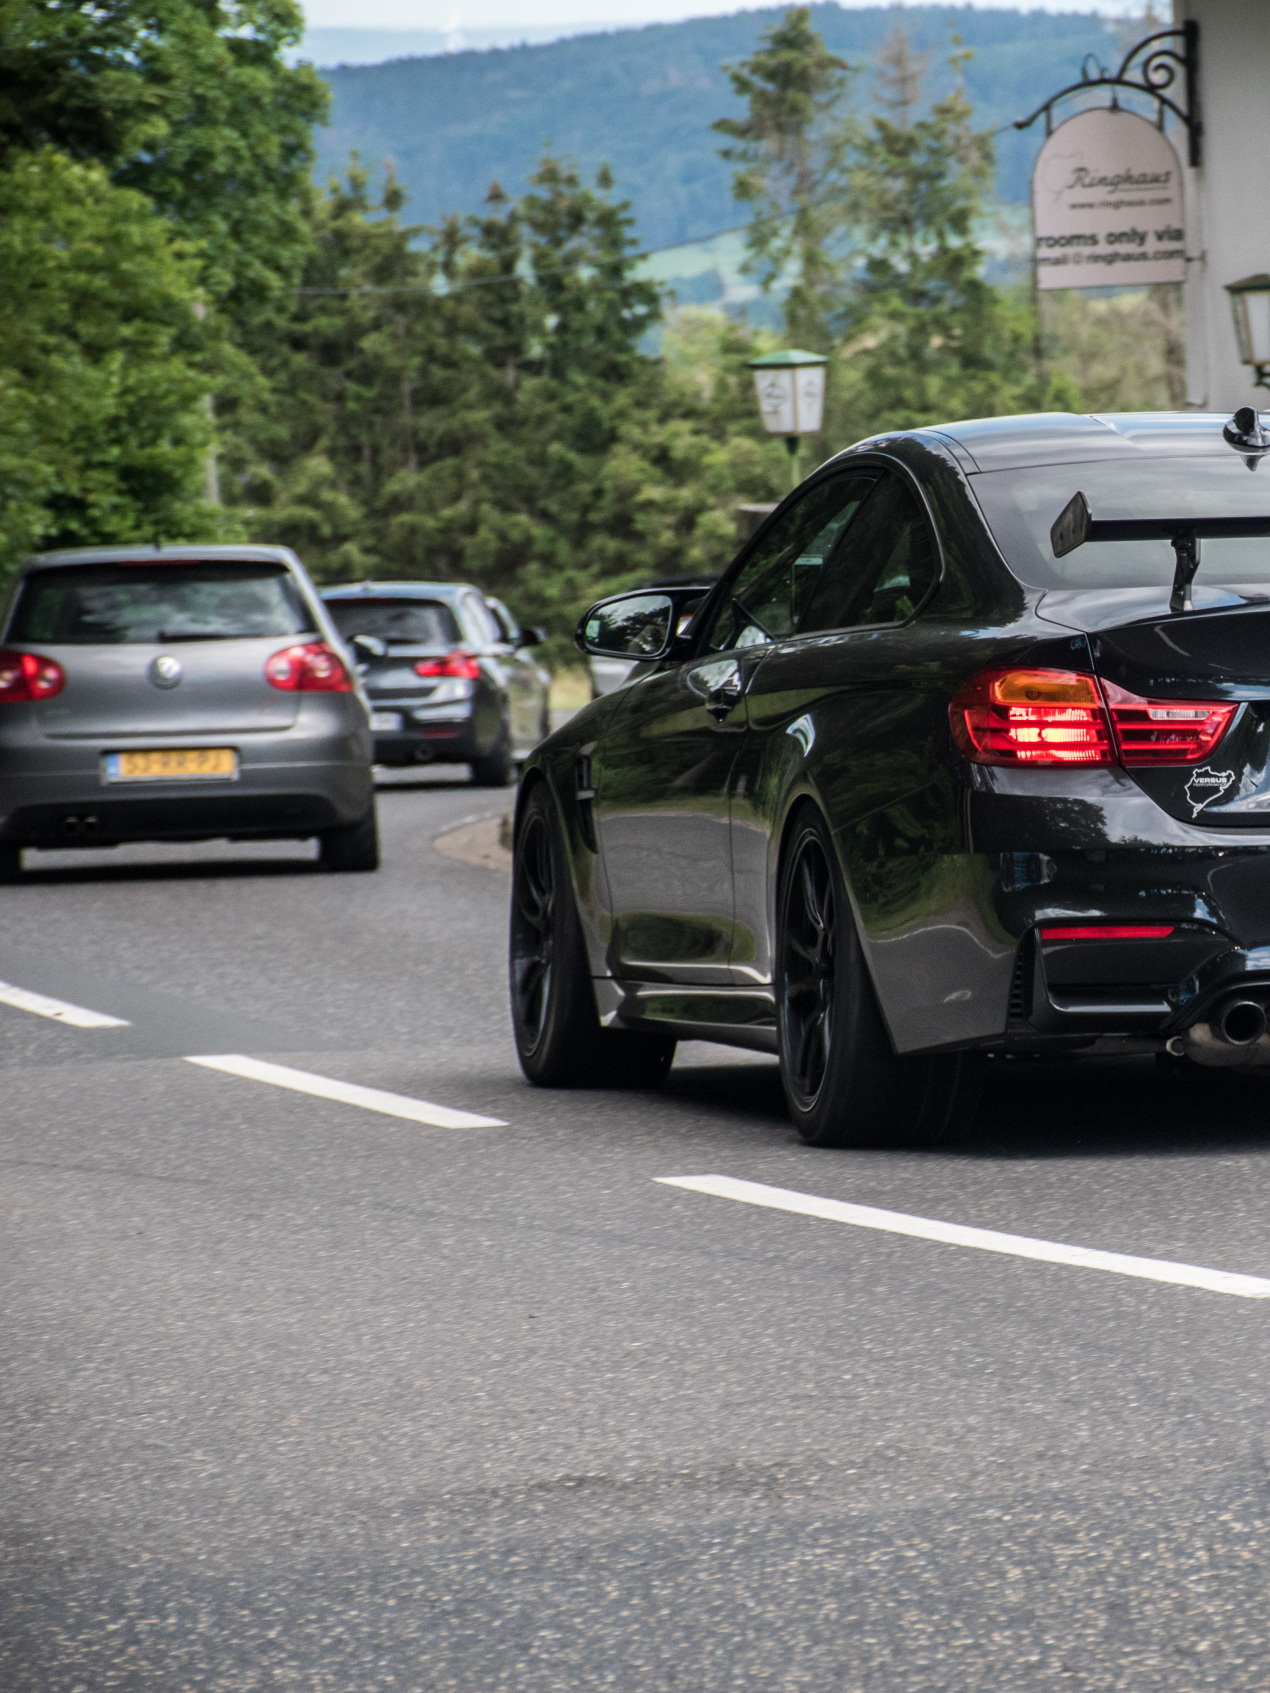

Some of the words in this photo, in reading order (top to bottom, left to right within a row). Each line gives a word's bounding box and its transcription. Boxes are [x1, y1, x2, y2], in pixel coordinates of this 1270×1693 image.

[1066, 167, 1172, 194] Ringhaus
[1037, 232, 1099, 247] rooms
[1105, 227, 1147, 247] only
[1154, 224, 1185, 242] via
